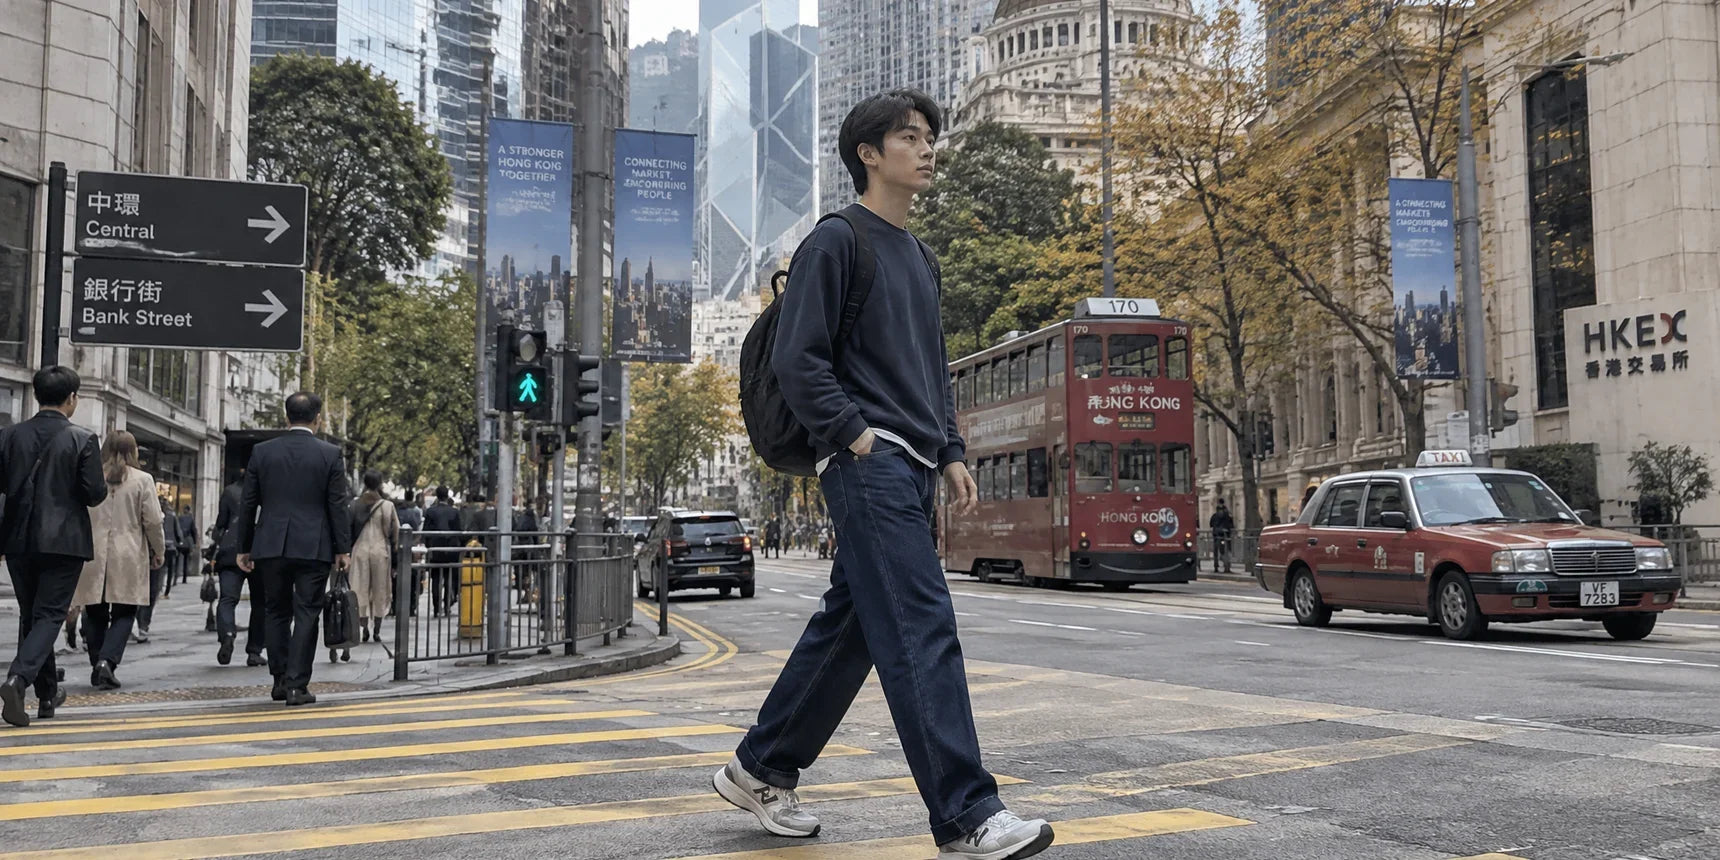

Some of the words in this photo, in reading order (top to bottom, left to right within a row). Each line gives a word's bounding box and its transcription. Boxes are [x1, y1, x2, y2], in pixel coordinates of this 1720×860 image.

[498, 145, 506, 155] A
[498, 157, 532, 168] HONG
[624, 156, 687, 170] CONNECTING
[87, 190, 140, 216] 中環
[86, 220, 155, 239] Central
[84, 277, 162, 303] 銀行街
[1108, 300, 1139, 314] 170
[82, 307, 129, 325] Bank
[135, 309, 193, 327] Street
[1073, 325, 1088, 334] 170
[1174, 326, 1187, 336] 170
[1585, 349, 1689, 380] 香港交易所
[1139, 396, 1180, 410] KONG
[1429, 452, 1466, 463] TAXI
[1101, 511, 1137, 523] HONG
[1141, 511, 1174, 524] KONG
[1592, 582, 1608, 593] VF
[1584, 593, 1617, 606] 7283
